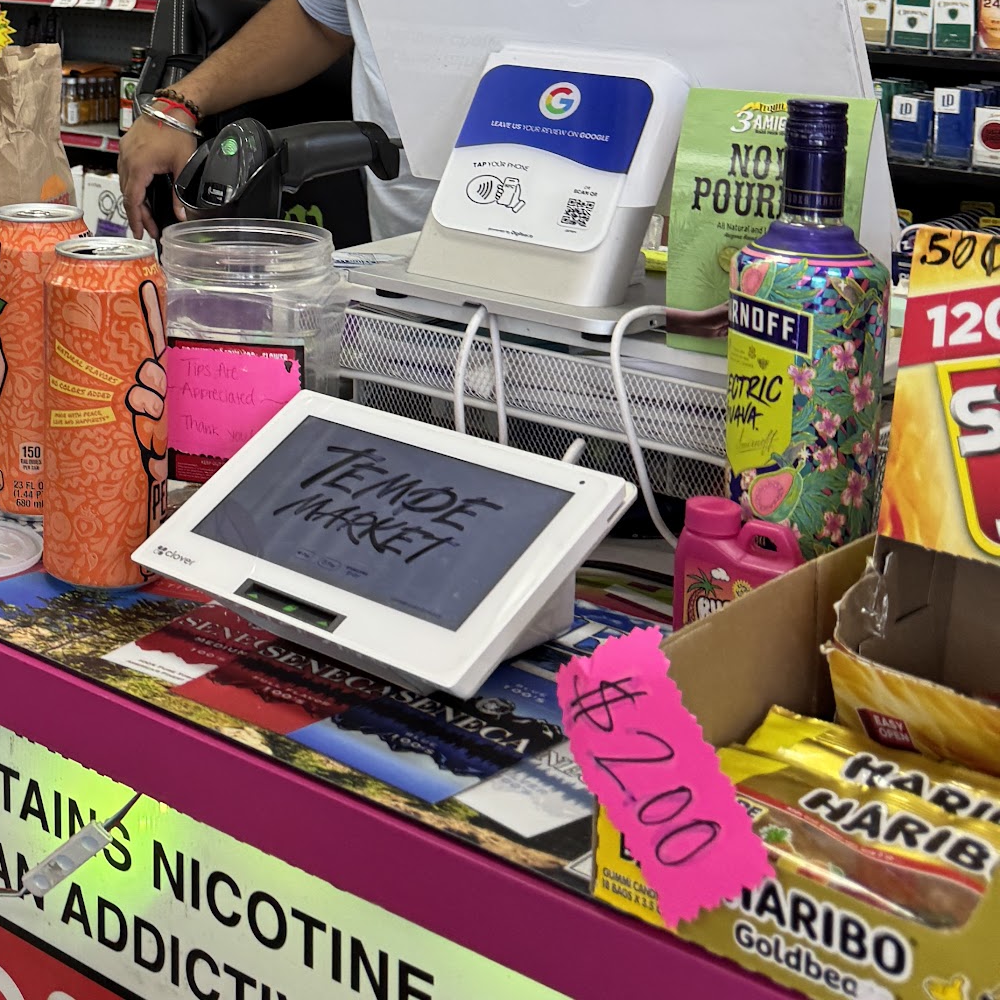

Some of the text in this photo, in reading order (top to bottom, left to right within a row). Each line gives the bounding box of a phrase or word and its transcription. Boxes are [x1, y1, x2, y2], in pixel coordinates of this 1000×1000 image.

[899, 102, 912, 117] LD
[941, 94, 954, 108] LD
[491, 119, 610, 142] LEAVE US YOUR REVIEW ON GOOGLE
[730, 110, 754, 133] 3
[488, 160, 506, 168] YOUR
[507, 162, 530, 172] PHONE
[573, 188, 589, 196] SCAN
[716, 222, 762, 235] All Natural and
[85, 363, 118, 385] FLAVORS
[181, 358, 241, 381] Tips Are
[59, 381, 86, 395] COLORS
[87, 390, 112, 399] ADDED
[182, 381, 256, 407] Appreciated
[181, 414, 220, 436] Thank
[22, 446, 41, 459] 150
[13, 480, 35, 490] 23 FL
[13, 490, 33, 499] (1.44
[299, 444, 504, 532] TEMPE
[272, 495, 461, 565] MARKET
[164, 547, 197, 567] clover
[194, 635, 249, 656] MEDIUM
[393, 686, 530, 755] SENECA
[873, 711, 905, 732] EASY
[878, 727, 911, 743] OPEN
[804, 790, 993, 872] HARIB
[602, 867, 631, 889] GUMMI
[612, 883, 634, 903] BAGS
[152, 840, 435, 1000] NICOTINE
[60, 882, 290, 1000] ADDICTI
